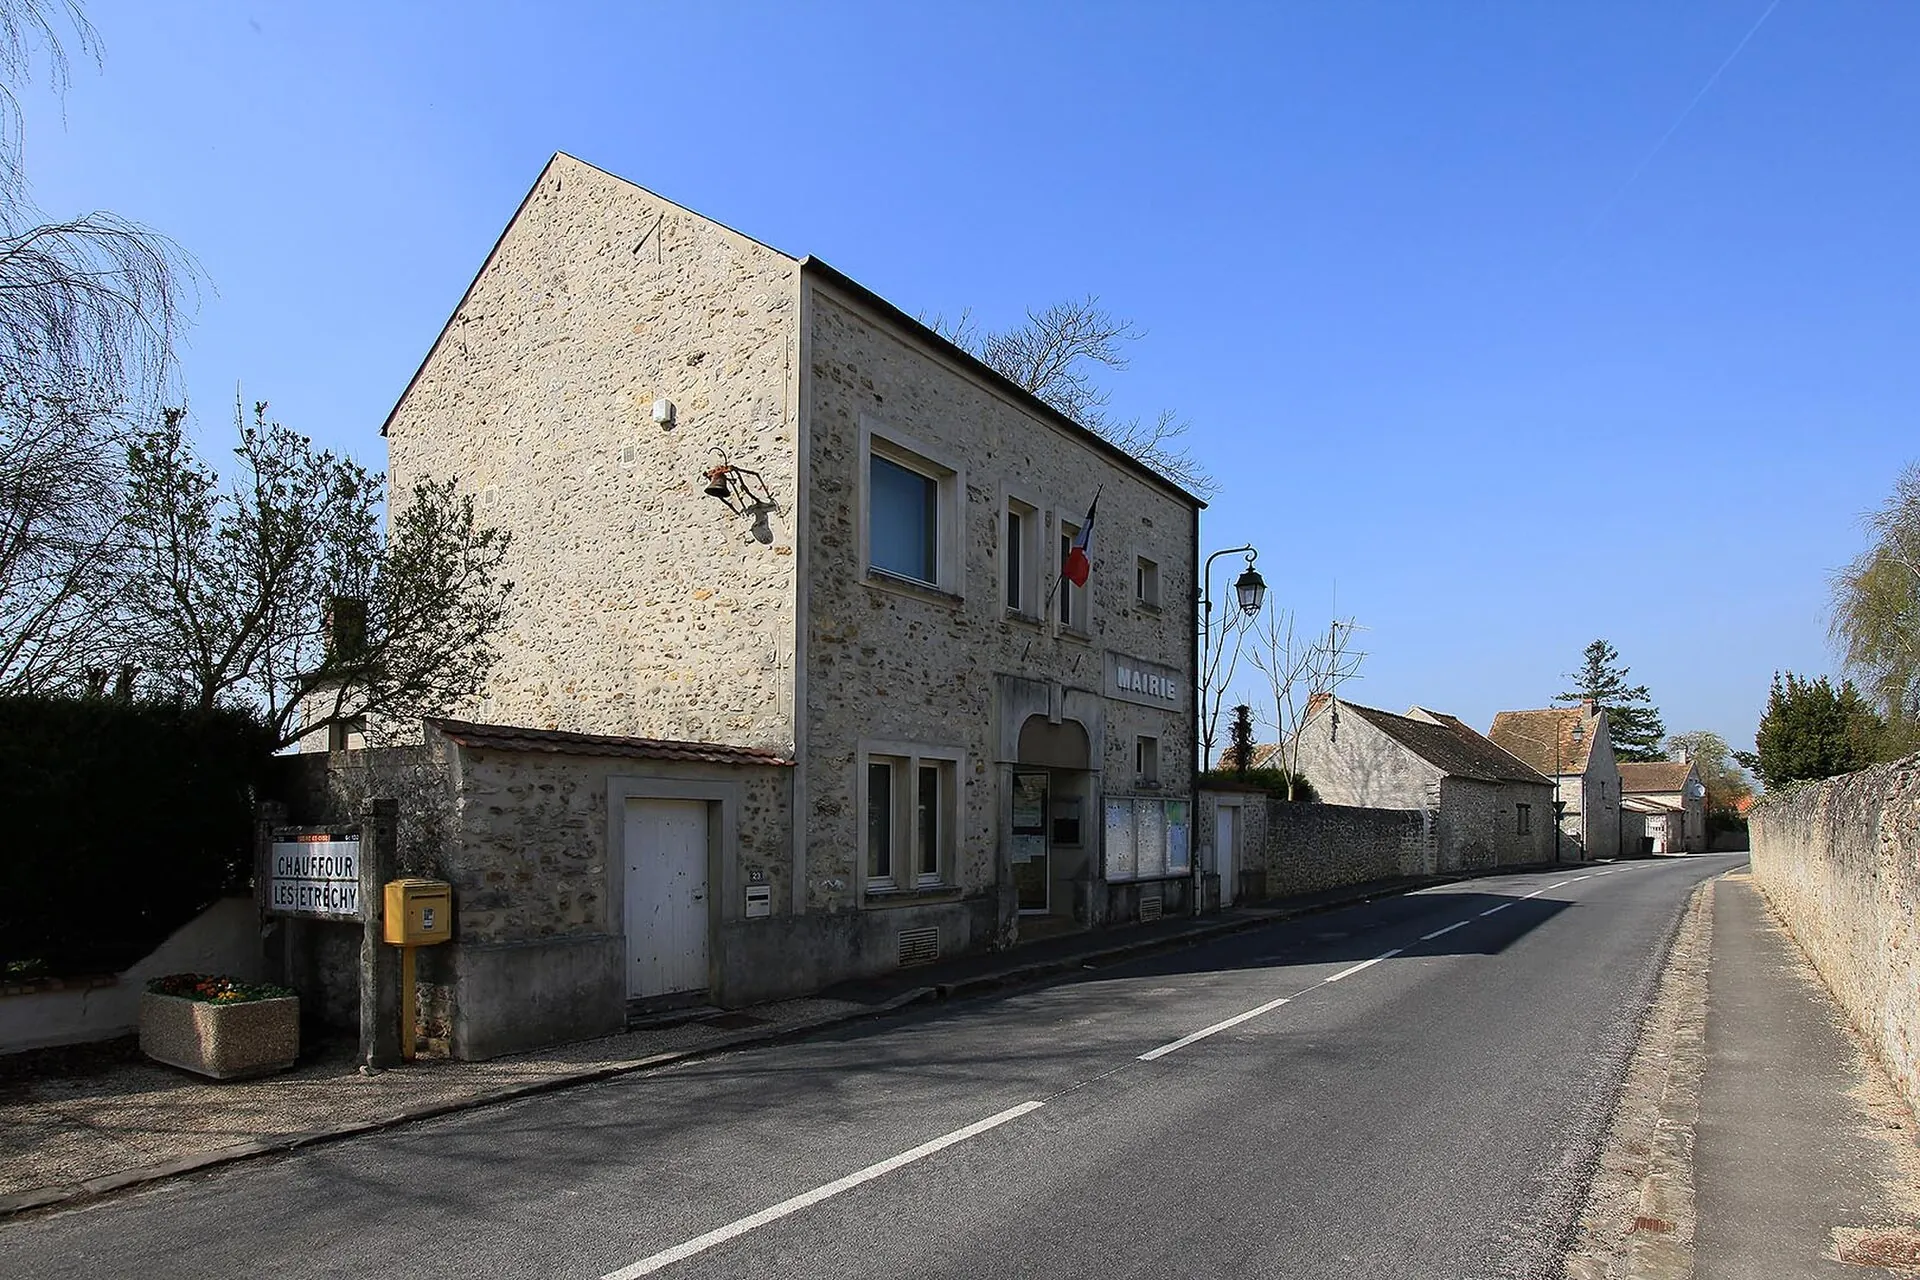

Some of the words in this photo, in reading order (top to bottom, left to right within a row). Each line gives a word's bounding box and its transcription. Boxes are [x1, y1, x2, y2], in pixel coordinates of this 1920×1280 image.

[1117, 666, 1176, 700] MAIRIE
[278, 856, 353, 877] CHAUFFOUR
[274, 881, 294, 905] LÈS
